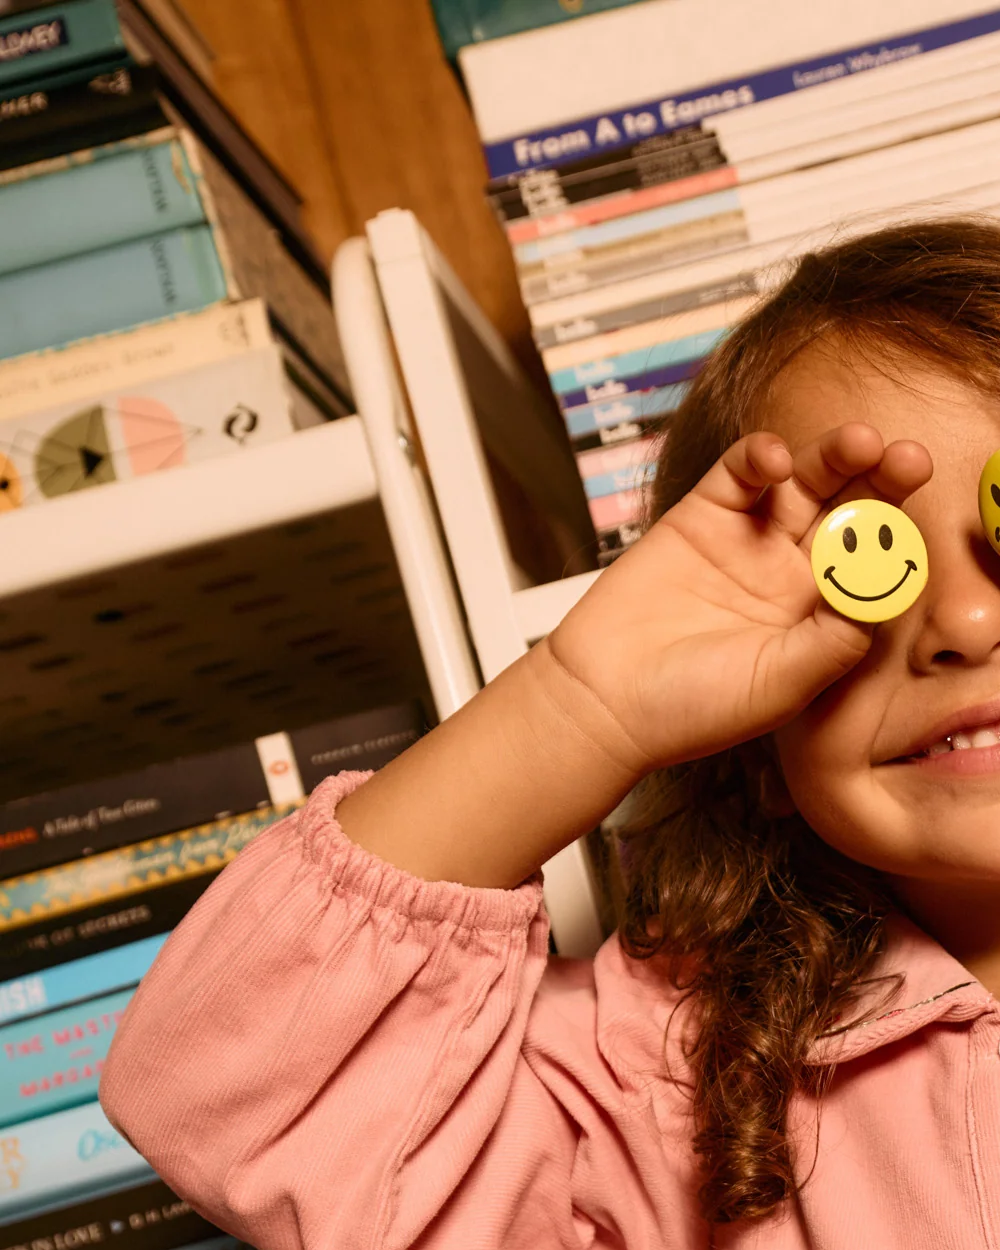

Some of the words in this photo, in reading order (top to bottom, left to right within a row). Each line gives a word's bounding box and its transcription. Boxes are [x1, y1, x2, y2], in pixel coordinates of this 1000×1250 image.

[513, 127, 591, 167] From
[595, 117, 622, 146] A
[622, 111, 657, 138] to
[660, 85, 754, 129] Eames
[4, 1035, 44, 1060] THE
[51, 1008, 131, 1046] MAST
[18, 1062, 106, 1097] MARGA
